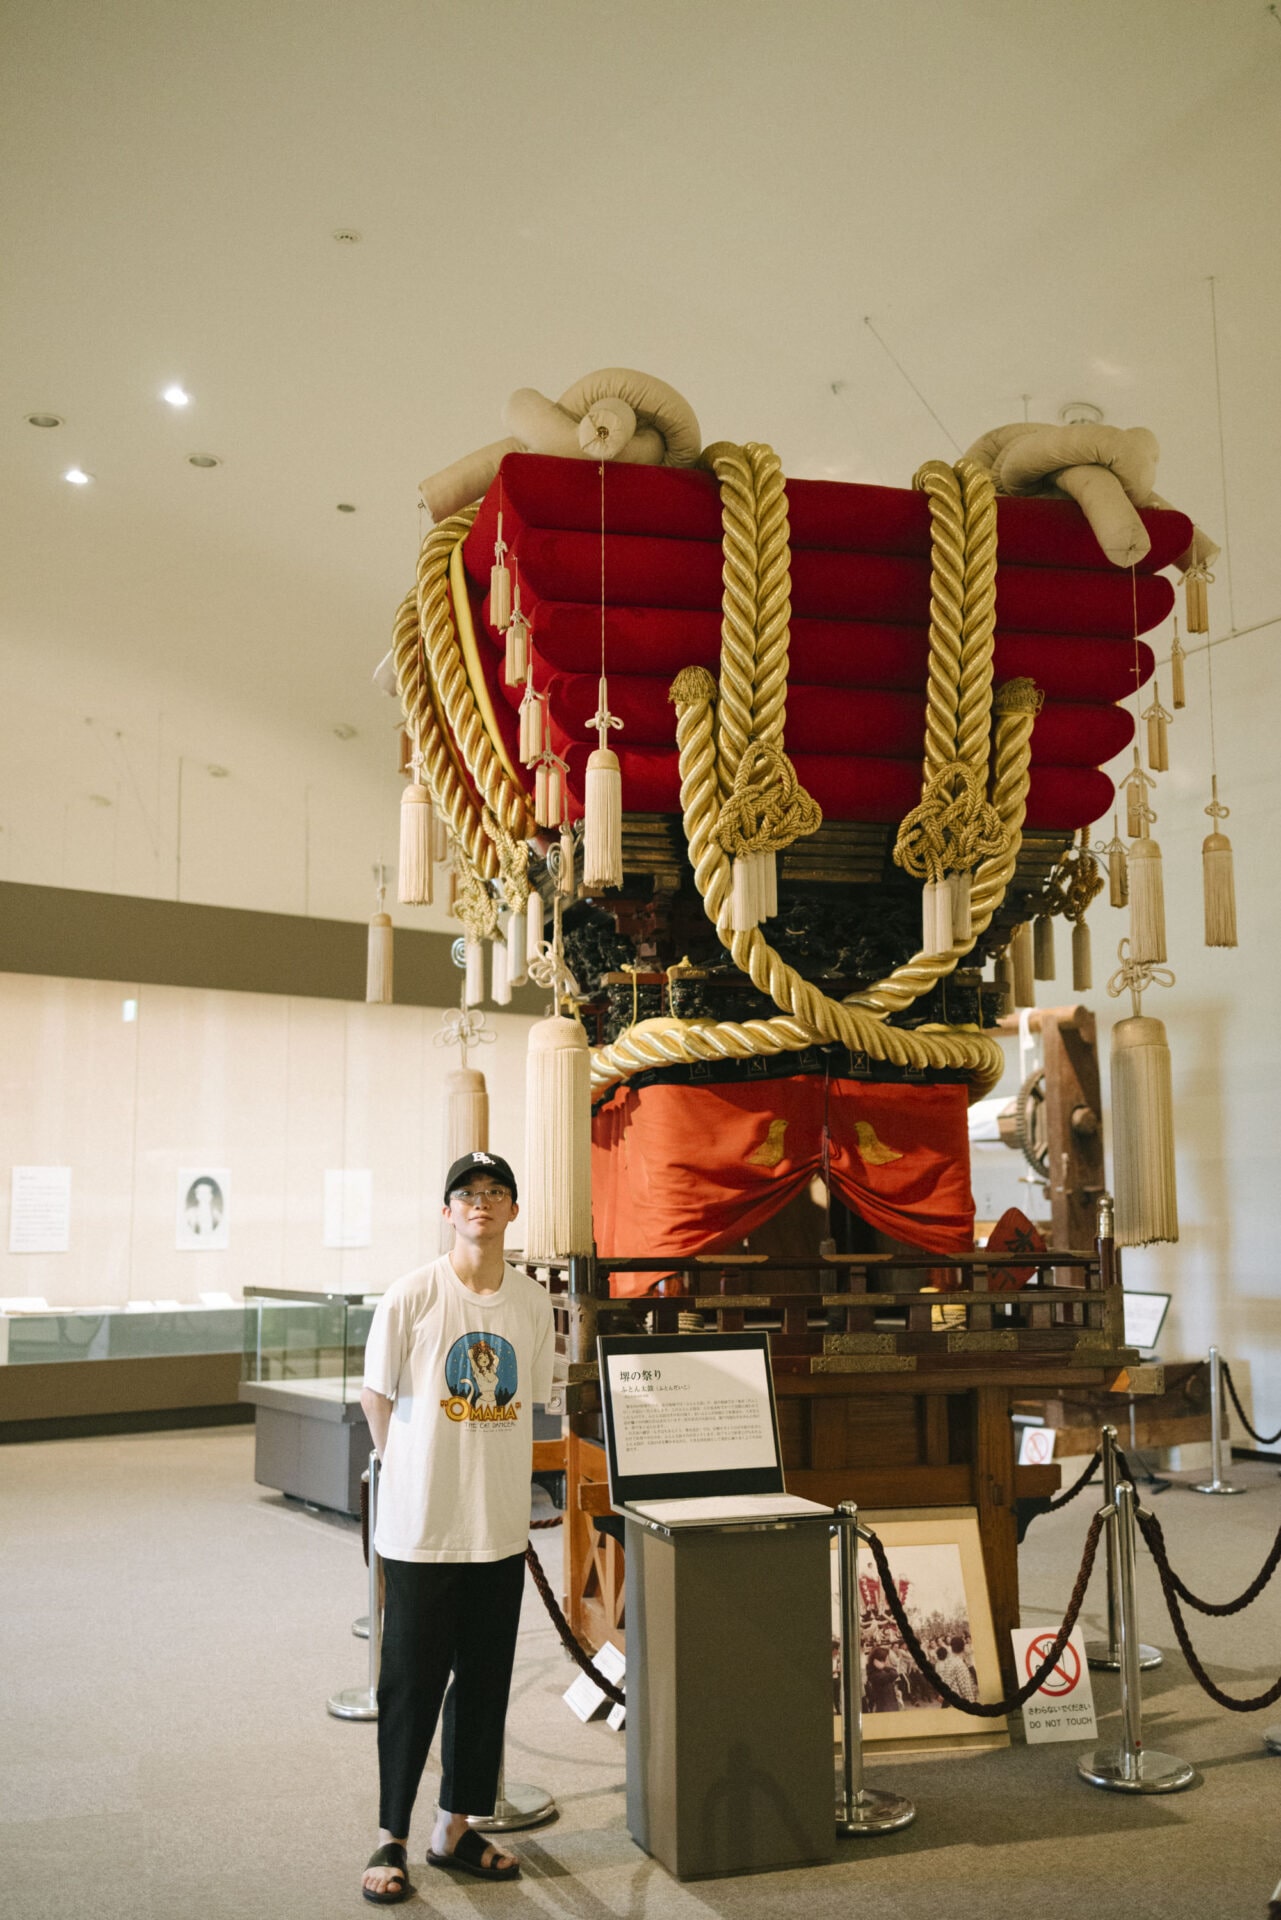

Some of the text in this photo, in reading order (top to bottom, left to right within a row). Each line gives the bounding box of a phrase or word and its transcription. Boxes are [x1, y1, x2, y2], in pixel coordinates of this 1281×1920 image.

[620, 1370, 662, 1382] 堺の祭り
[1028, 1704, 1091, 1715] さわらないでください
[1029, 1717, 1093, 1729] DO NOT TOUCH
